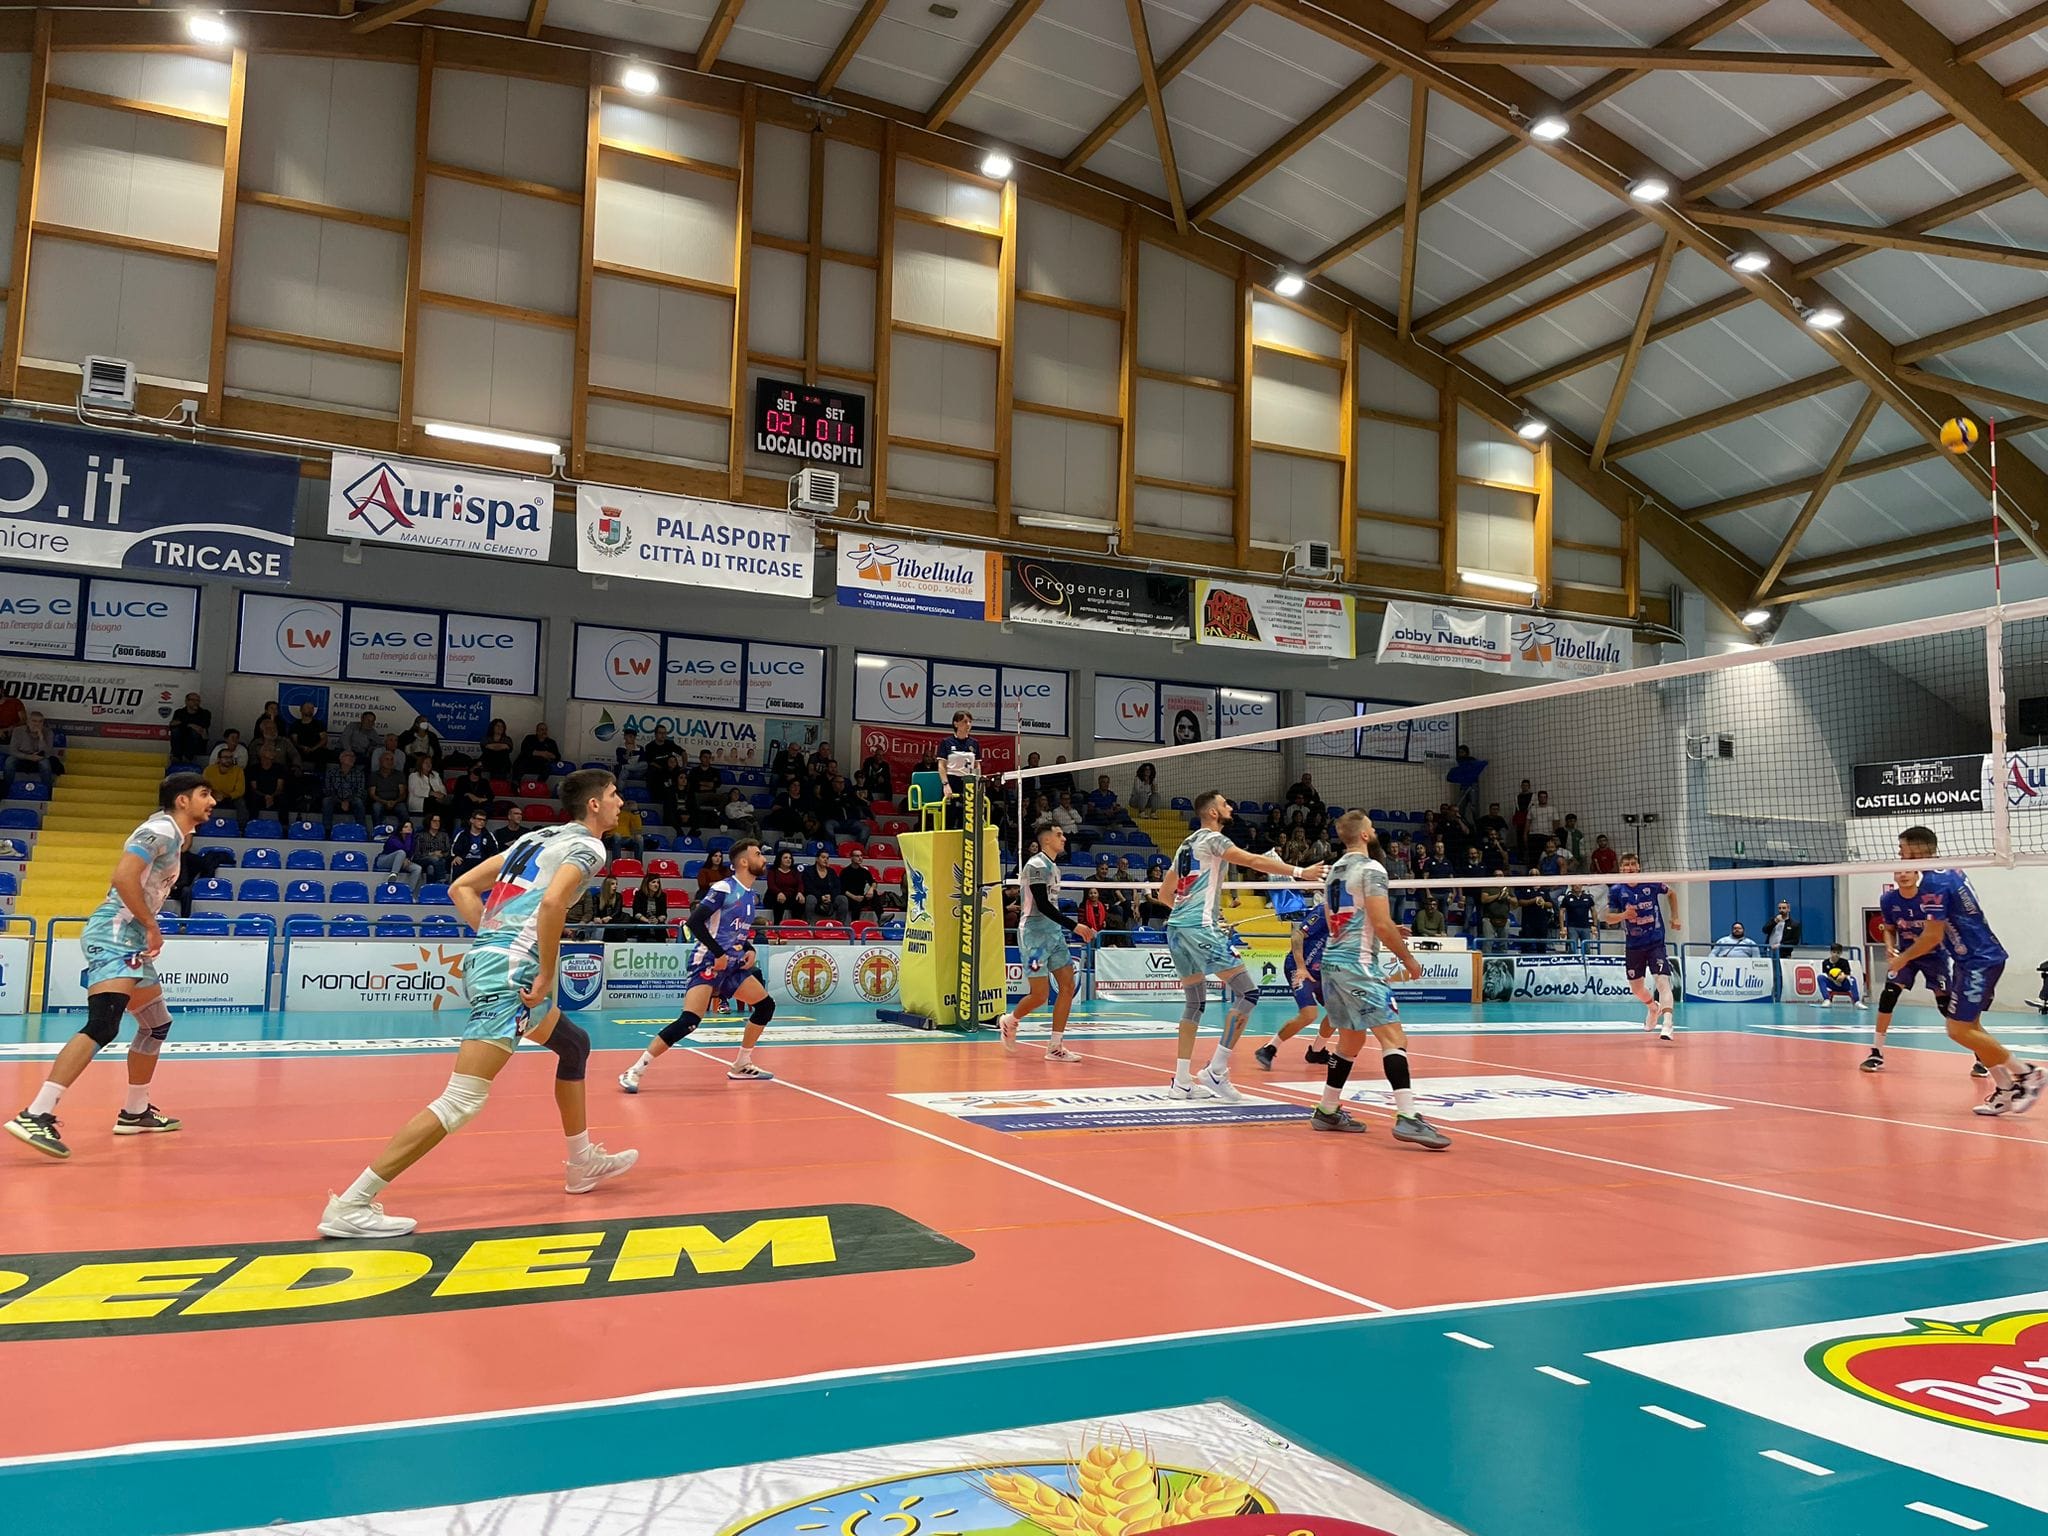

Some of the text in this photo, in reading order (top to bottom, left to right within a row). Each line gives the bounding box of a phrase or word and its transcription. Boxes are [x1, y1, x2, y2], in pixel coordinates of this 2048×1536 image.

[777, 398, 797, 412] SET
[825, 407, 845, 421] SET
[349, 468, 540, 541] Aurispa
[656, 517, 791, 553] PALASPORT
[400, 532, 538, 557] MANUFATTI IN CEMENTO
[152, 540, 281, 577] TRICASE
[640, 543, 803, 579] CITTÀ DI TRICASE
[897, 557, 974, 585] libellula
[897, 580, 973, 596] soc. coop. sociale
[1034, 576, 1130, 599] Progeneral
[882, 602, 915, 611] FORMAZIONE
[916, 605, 956, 615] PROFESSIONALE
[287, 628, 331, 650] LW
[350, 631, 407, 648] GAS
[1392, 627, 1433, 645] obby
[1437, 631, 1497, 651] Nautica
[118, 647, 167, 659] 800 660850
[1555, 636, 1621, 664] libellula
[613, 657, 651, 677] LW
[666, 660, 715, 674] GAS
[472, 676, 513, 687] 800 660850
[887, 682, 919, 699] LW
[933, 684, 973, 697] GAS
[333, 692, 380, 702] CERAMICHE
[333, 702, 397, 712] ARREDO BAGNO
[1121, 702, 1149, 719] LW
[623, 714, 757, 742] ACQUAVIVA
[677, 737, 758, 750] TECHNOLOGIES
[965, 782, 975, 833] BANCA
[1856, 793, 1921, 809] CASTELLO
[963, 838, 974, 896] CREDEM
[962, 904, 973, 956] BANCA
[613, 948, 679, 970] Elettro
[786, 949, 810, 985] DONARE
[823, 952, 838, 984] AMARE
[854, 949, 875, 984] DONARE
[1658, 963, 1664, 973] 7
[185, 972, 229, 985] INDINO
[302, 967, 447, 991] Mondoradio
[1097, 980, 1141, 990] REALIZZAZIONE
[1141, 981, 1147, 990] DI
[1148, 982, 1161, 990] CAPI
[1514, 968, 1582, 999] Leones
[1940, 981, 1946, 991] 3
[360, 992, 433, 1003] TUTTI FRUTTI
[960, 961, 972, 1021] CREDEM
[1006, 1121, 1064, 1129] ENTE
[1094, 1116, 1200, 1125] FORMAZIONE
